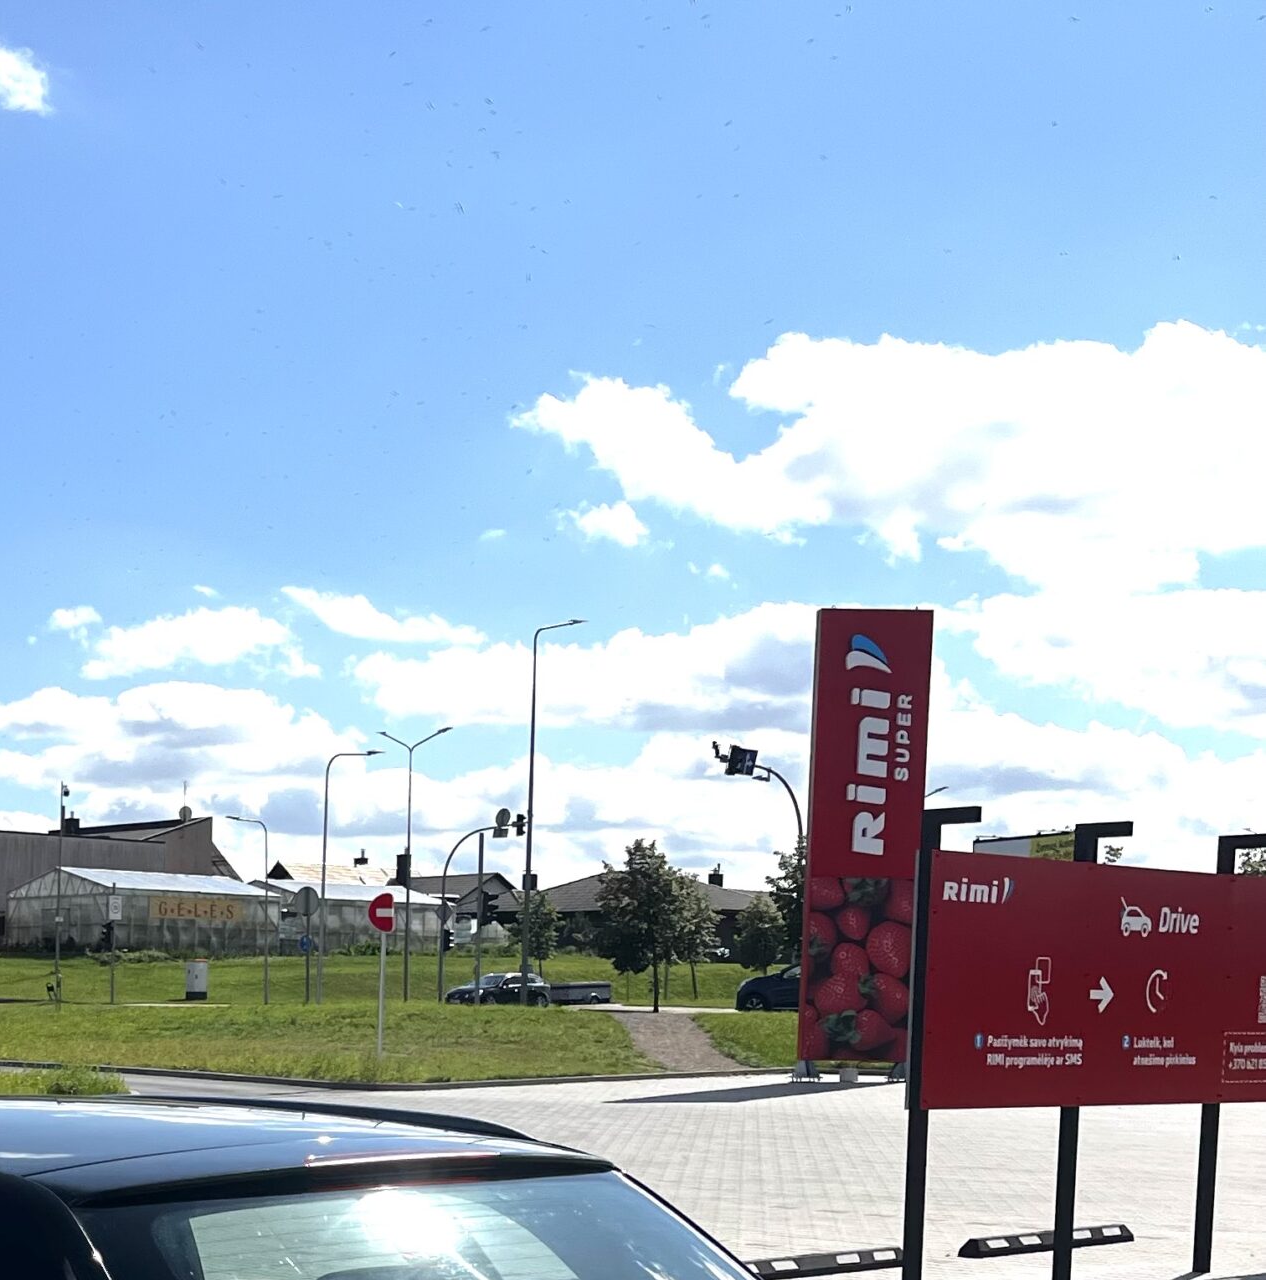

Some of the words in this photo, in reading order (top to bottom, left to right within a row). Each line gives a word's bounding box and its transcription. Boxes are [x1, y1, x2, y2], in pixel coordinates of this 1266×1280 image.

[894, 693, 913, 782] SUPER
[846, 688, 891, 856] Rimi
[942, 877, 999, 904] Rimi
[1158, 906, 1200, 934] Drive
[1065, 1053, 1083, 1066] SMS
